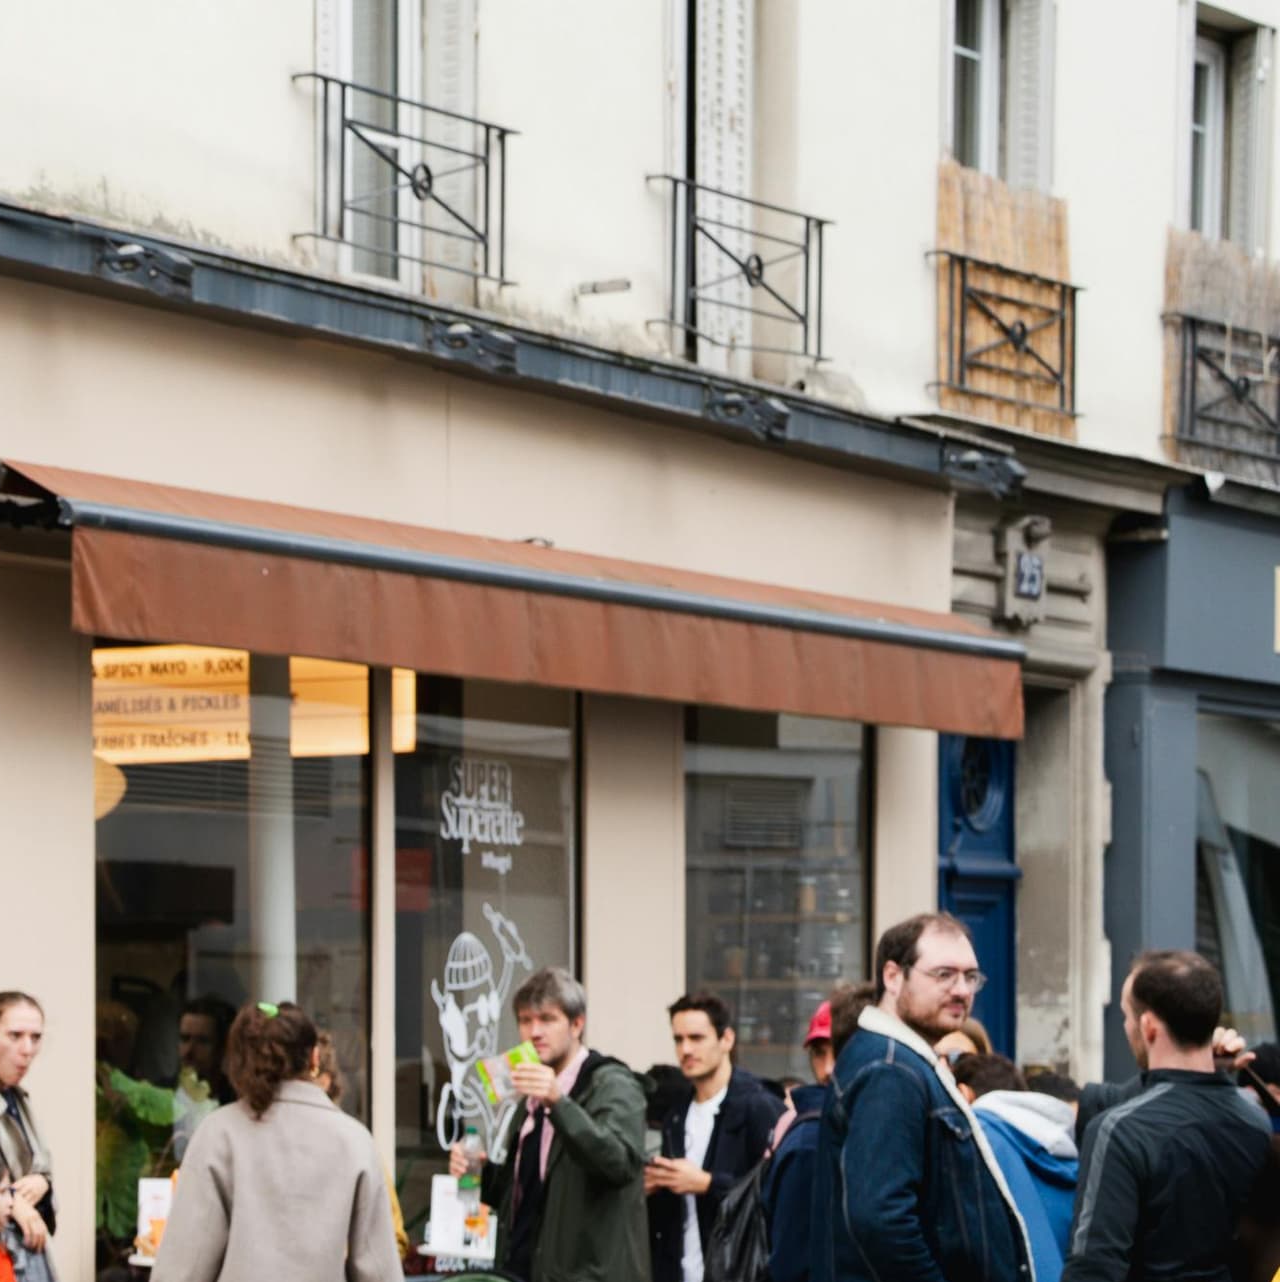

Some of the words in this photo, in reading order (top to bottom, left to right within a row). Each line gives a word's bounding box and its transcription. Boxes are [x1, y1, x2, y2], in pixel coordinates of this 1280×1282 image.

[103, 663, 143, 678] SPICY
[149, 660, 187, 675] MAYO
[182, 693, 242, 711] PICKLES
[448, 757, 512, 808] SUPER
